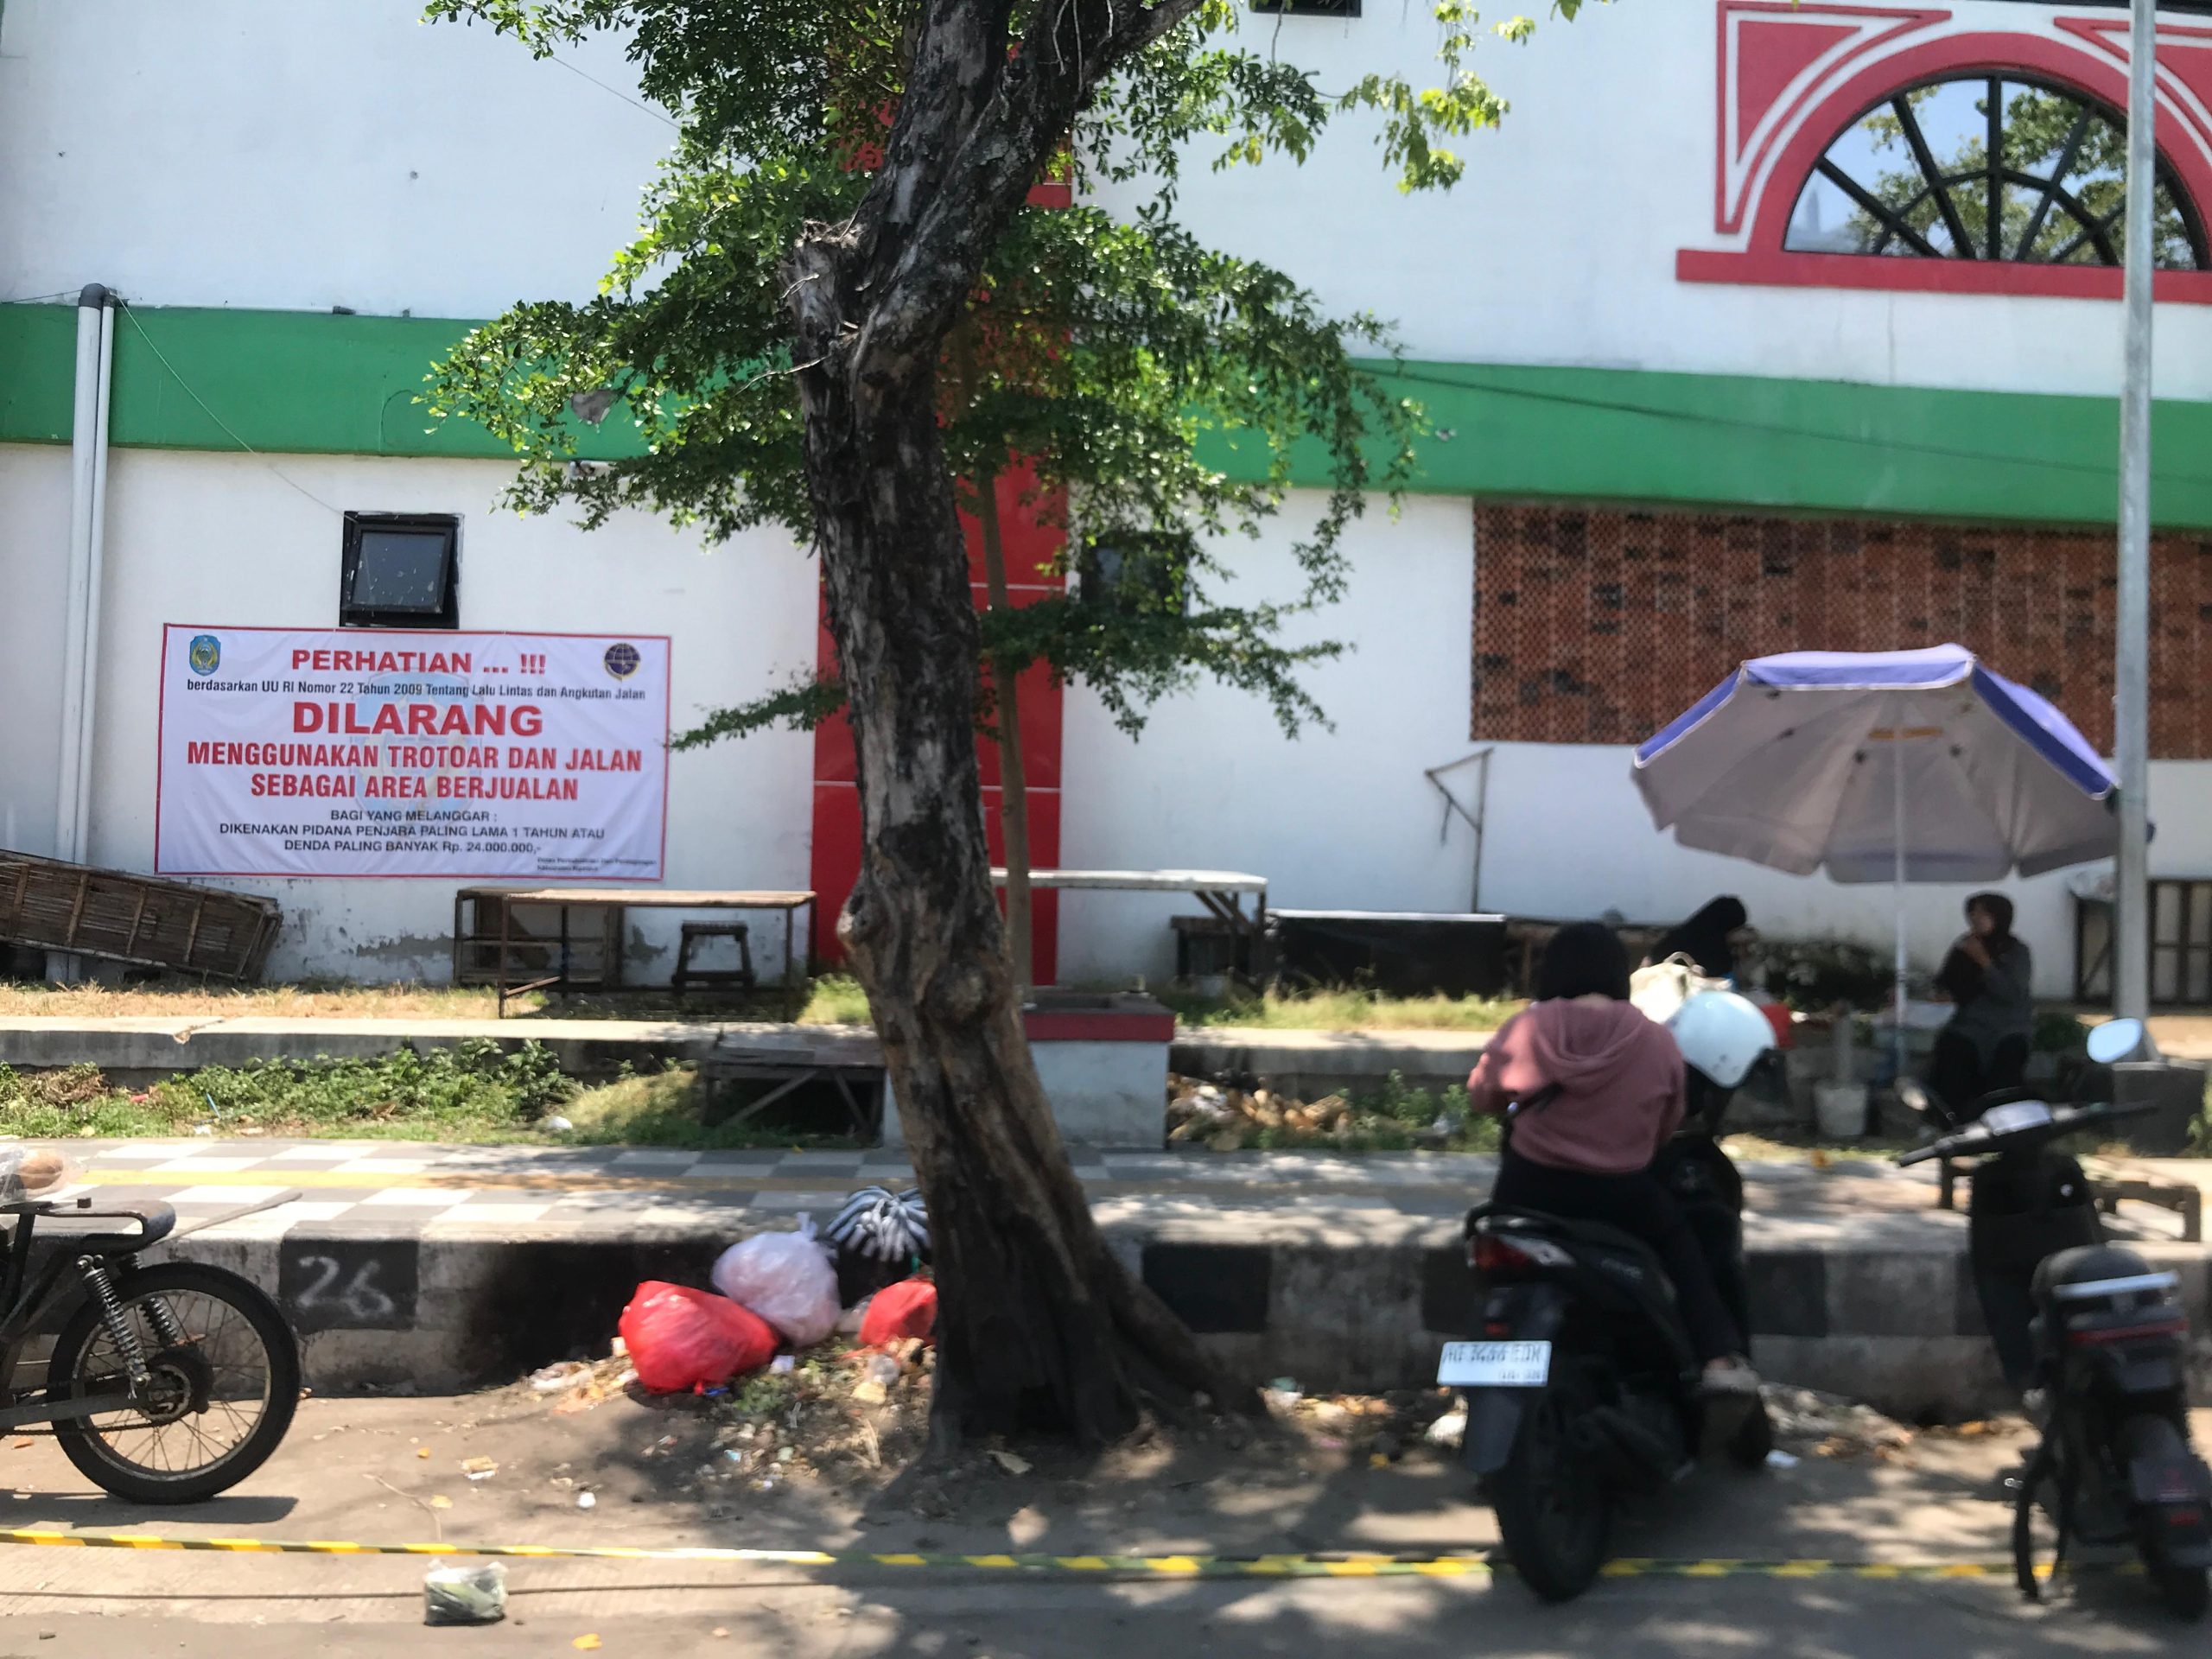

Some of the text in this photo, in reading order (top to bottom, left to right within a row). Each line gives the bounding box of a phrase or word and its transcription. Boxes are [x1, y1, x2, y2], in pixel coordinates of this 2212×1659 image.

[292, 649, 472, 673] PERHATIAN
[520, 653, 546, 675] !!!
[187, 679, 645, 701] berdasarkan UU RI Nomor 22 Tahun 2009 Tentang Lalu Lintas dan Angkutan Jalan
[293, 702, 543, 736] DILARANG
[188, 741, 642, 772] MENGGUNAKAN TROTOAR DAN JALAN
[251, 773, 578, 801] SEBAGAI AREA BERJUALAN
[331, 810, 363, 821] BAGI
[366, 810, 402, 822] YANG
[405, 810, 490, 822] MELANGGAR
[219, 823, 605, 839] DIKENAKAN PIDANA PENJARA PALING LAMA 1 TAHUN ATAU
[284, 840, 330, 851] DENDA
[334, 840, 382, 852] PALING
[385, 841, 438, 852] BANYAK
[442, 842, 463, 855] Rp.
[297, 1255, 394, 1319] 26
